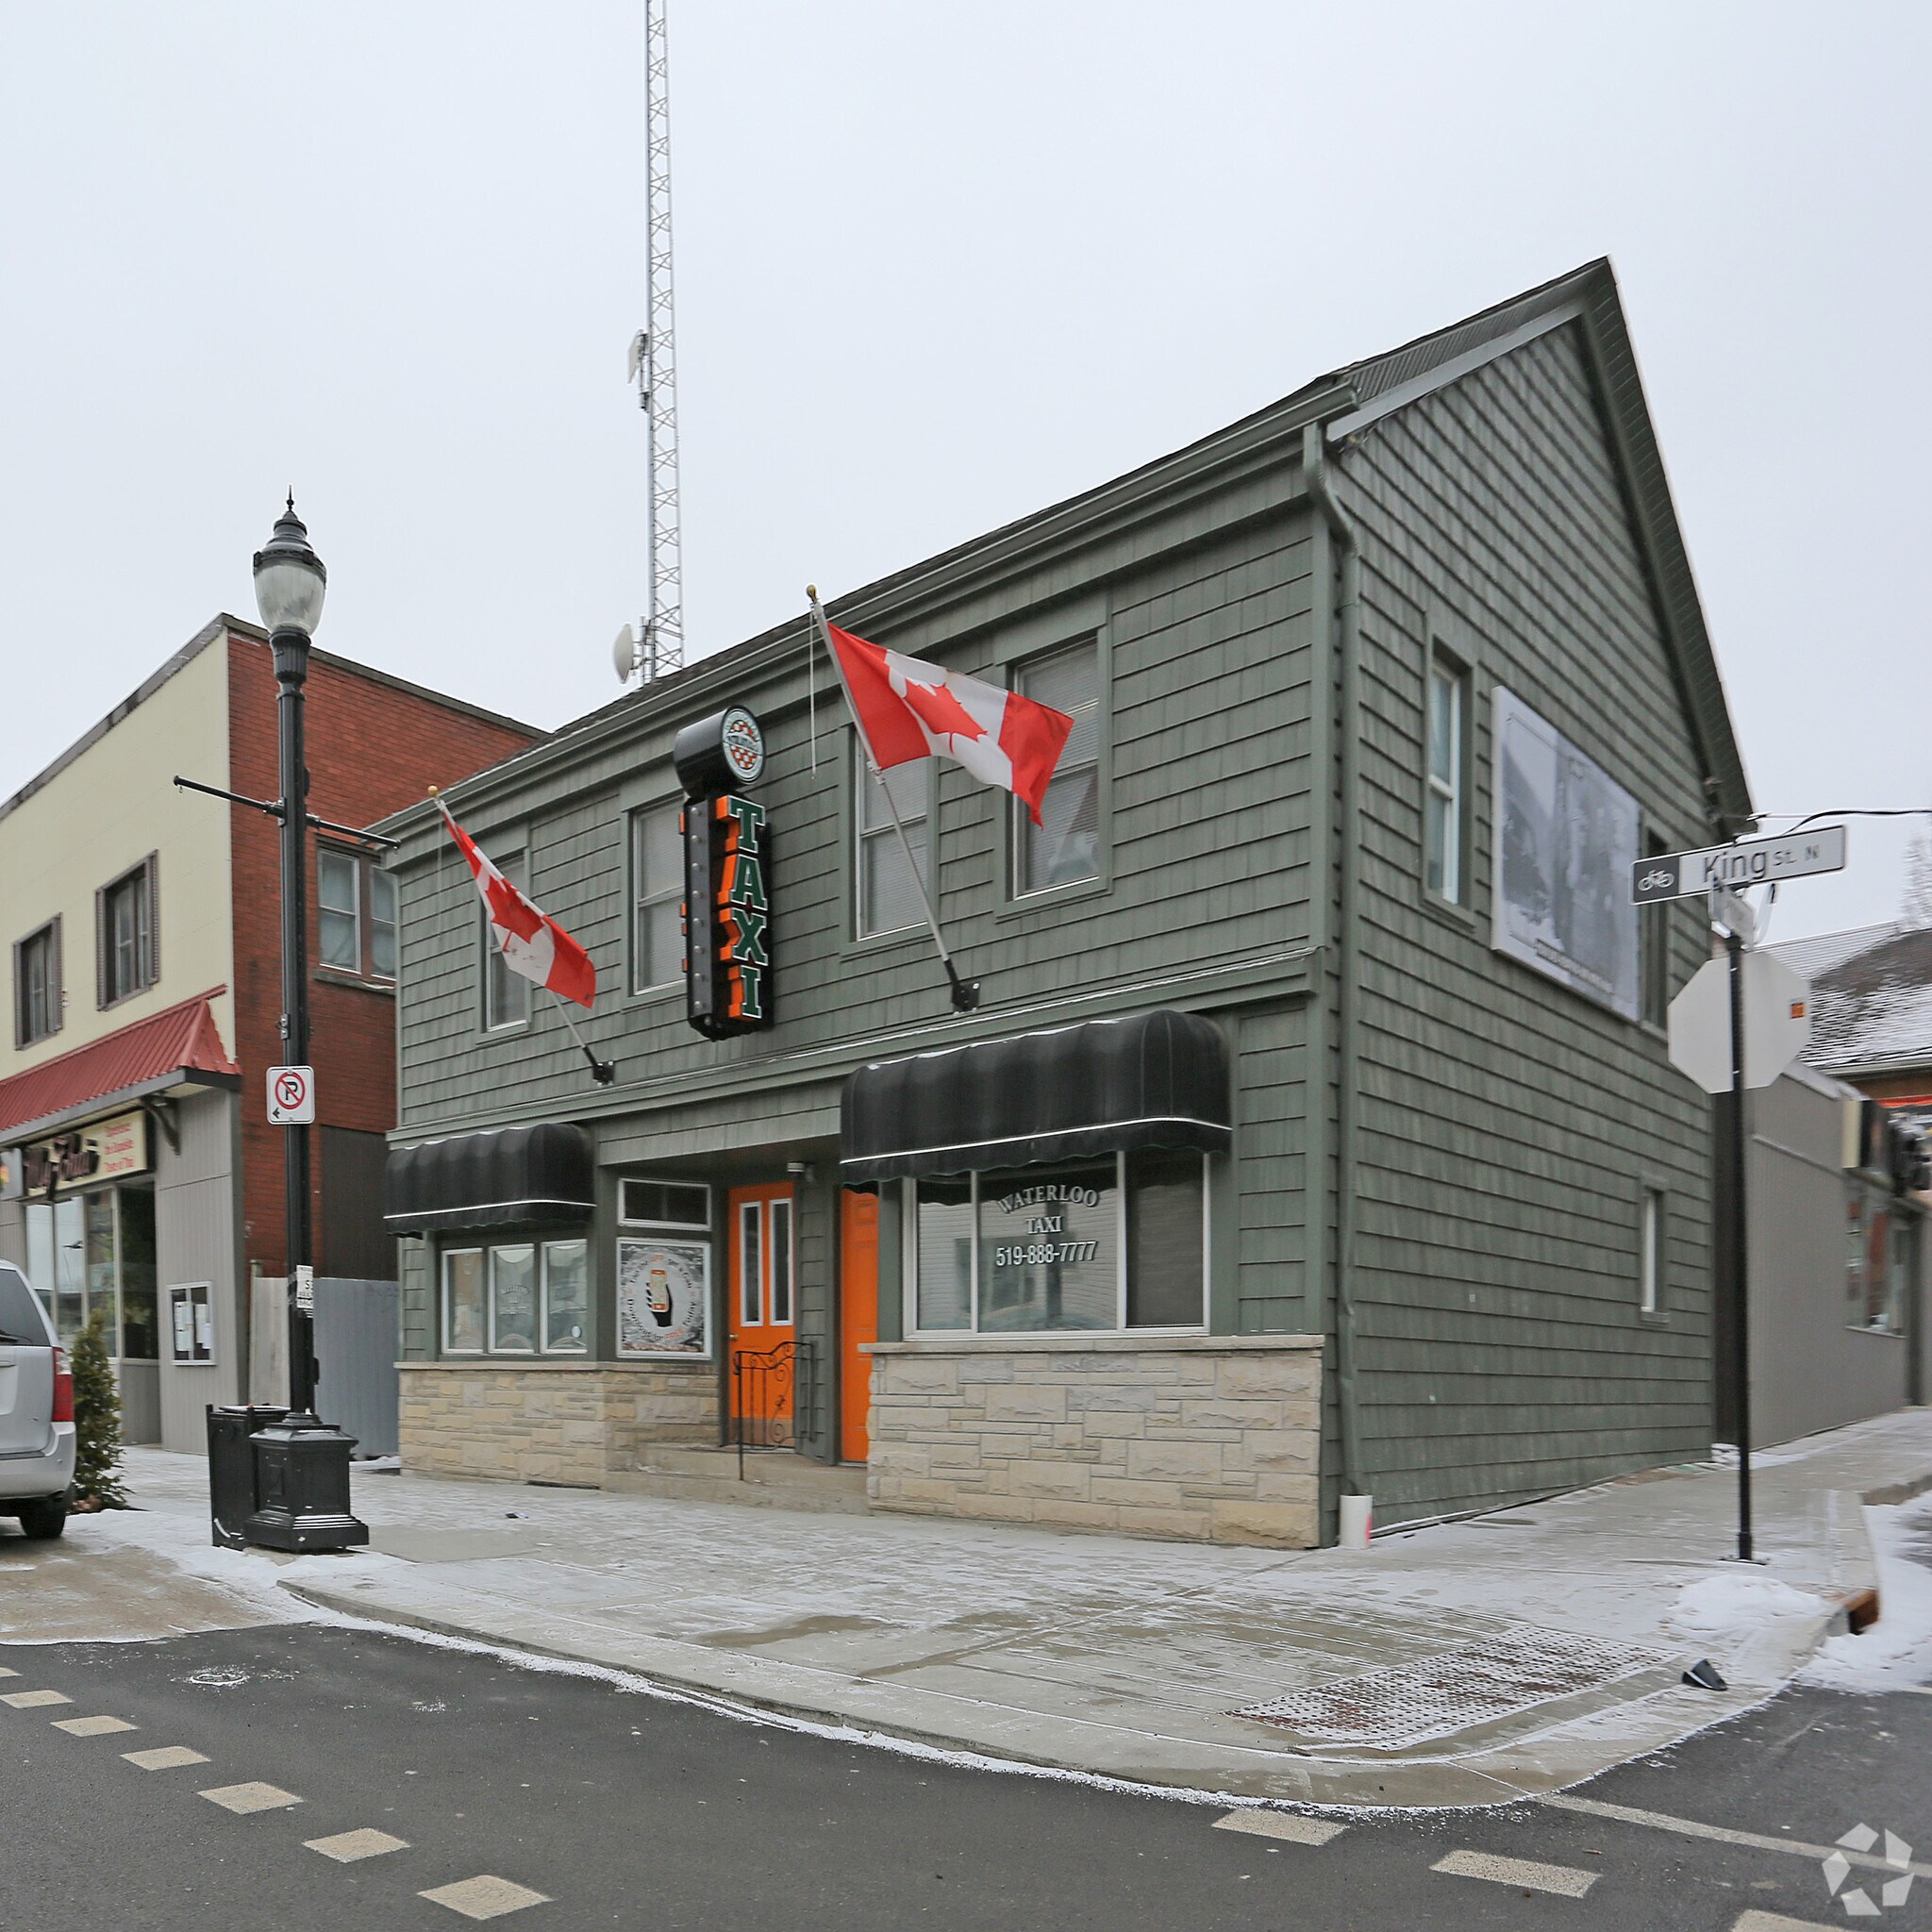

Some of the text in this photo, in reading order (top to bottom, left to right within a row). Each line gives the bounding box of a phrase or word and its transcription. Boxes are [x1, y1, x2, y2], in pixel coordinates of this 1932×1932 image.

[1703, 850, 1767, 883] King
[726, 794, 769, 1020] TAXI
[997, 1183, 1099, 1214] WATERLOO
[1024, 1215, 1063, 1235] TAXI
[995, 1240, 1098, 1267] 519-888-7777
